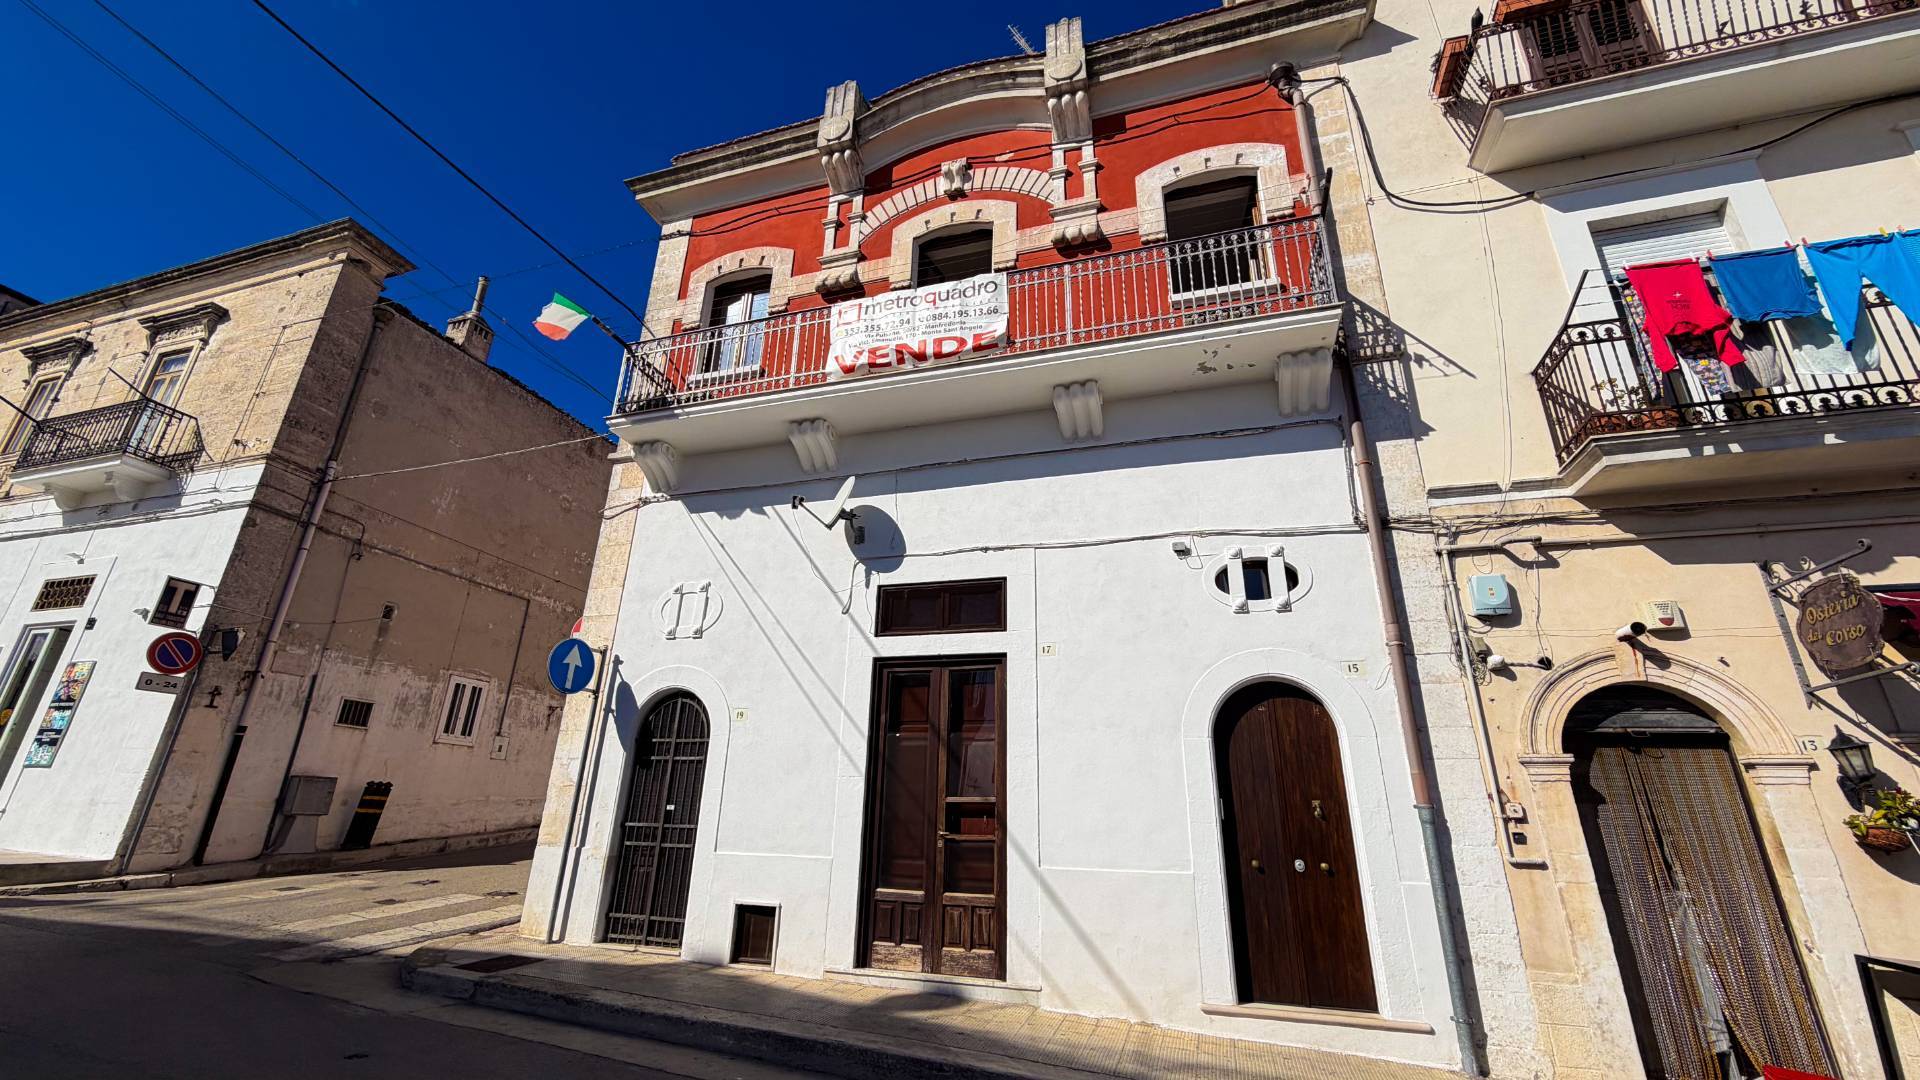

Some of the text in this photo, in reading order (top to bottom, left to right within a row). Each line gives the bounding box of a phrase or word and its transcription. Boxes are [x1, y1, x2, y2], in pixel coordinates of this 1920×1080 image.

[864, 281, 998, 315] metroquadro
[926, 305, 1000, 322] 0884.195.13.66
[844, 318, 912, 338] 353.355.72.94
[834, 329, 999, 374] VENDE
[168, 579, 197, 614] T
[1806, 590, 1861, 625] Osteria
[1826, 624, 1867, 647] Corso
[1042, 645, 1052, 653] 17
[1347, 663, 1359, 673] 15
[144, 678, 154, 687] 0
[162, 681, 178, 690] 24
[736, 711, 744, 719] 19
[1802, 739, 1819, 752] 13
